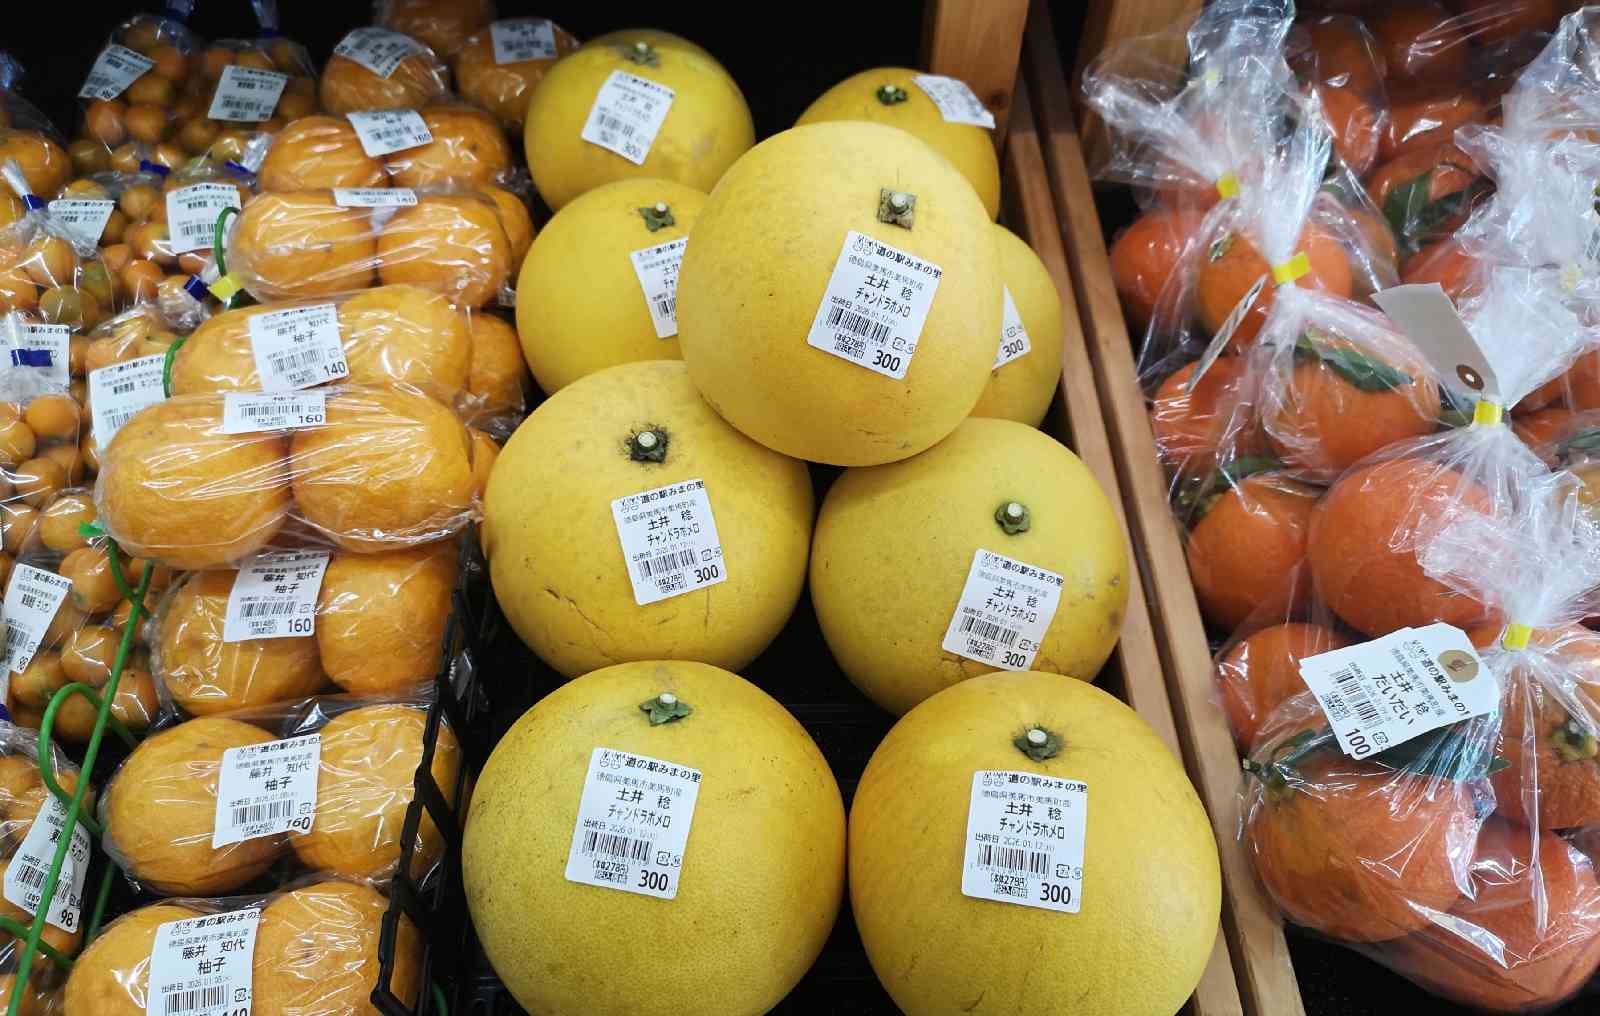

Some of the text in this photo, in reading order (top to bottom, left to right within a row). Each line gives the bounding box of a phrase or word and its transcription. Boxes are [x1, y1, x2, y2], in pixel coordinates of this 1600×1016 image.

[864, 274, 890, 291] 土井
[1003, 339, 1024, 358] 300
[323, 361, 346, 376] 140
[872, 350, 901, 372] 300
[299, 414, 323, 424] 160
[648, 515, 670, 531] 土井
[694, 564, 719, 584] 300
[288, 617, 312, 633] 160
[1001, 651, 1026, 668] 300
[1390, 671, 1414, 693] 土井
[1371, 673, 1416, 726] だいだい
[260, 736, 321, 753] 道の駅みまの
[1345, 728, 1371, 757] 100
[625, 757, 702, 783] 道の駅みまの里
[1008, 774, 1087, 793] 道の駅みまの里
[615, 787, 645, 804] 土井
[1005, 802, 1033, 816] 土井
[286, 816, 311, 830] 160
[638, 869, 669, 891] 300
[1040, 882, 1071, 905] 300
[60, 909, 74, 927] 98
[195, 911, 260, 929] 道の駅みまの
[182, 938, 246, 960] 藤井 知代
[198, 956, 227, 975] 柚子
